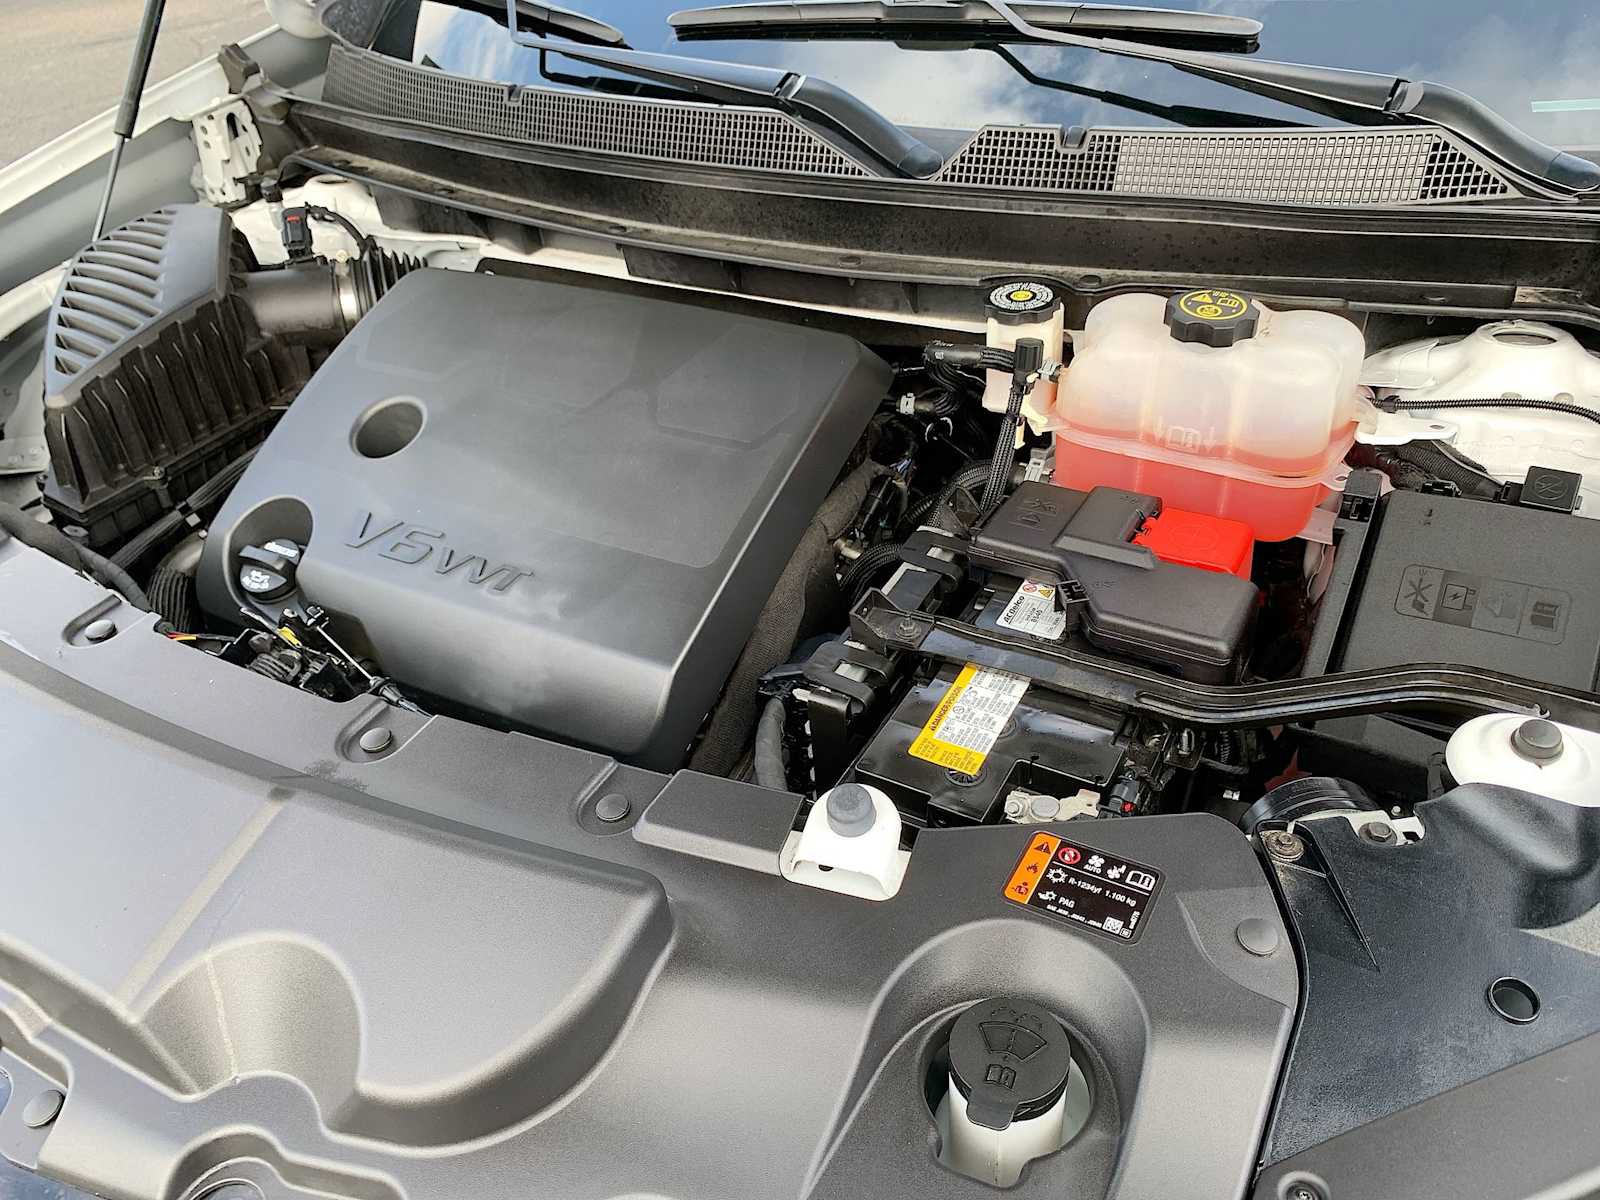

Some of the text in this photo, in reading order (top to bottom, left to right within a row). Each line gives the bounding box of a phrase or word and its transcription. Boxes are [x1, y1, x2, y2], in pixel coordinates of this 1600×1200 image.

[343, 511, 446, 564] V6
[1083, 863, 1102, 874] AUTO
[1068, 878, 1137, 907] R-1234yf 1.100 kg
[1058, 897, 1075, 909] PAG
